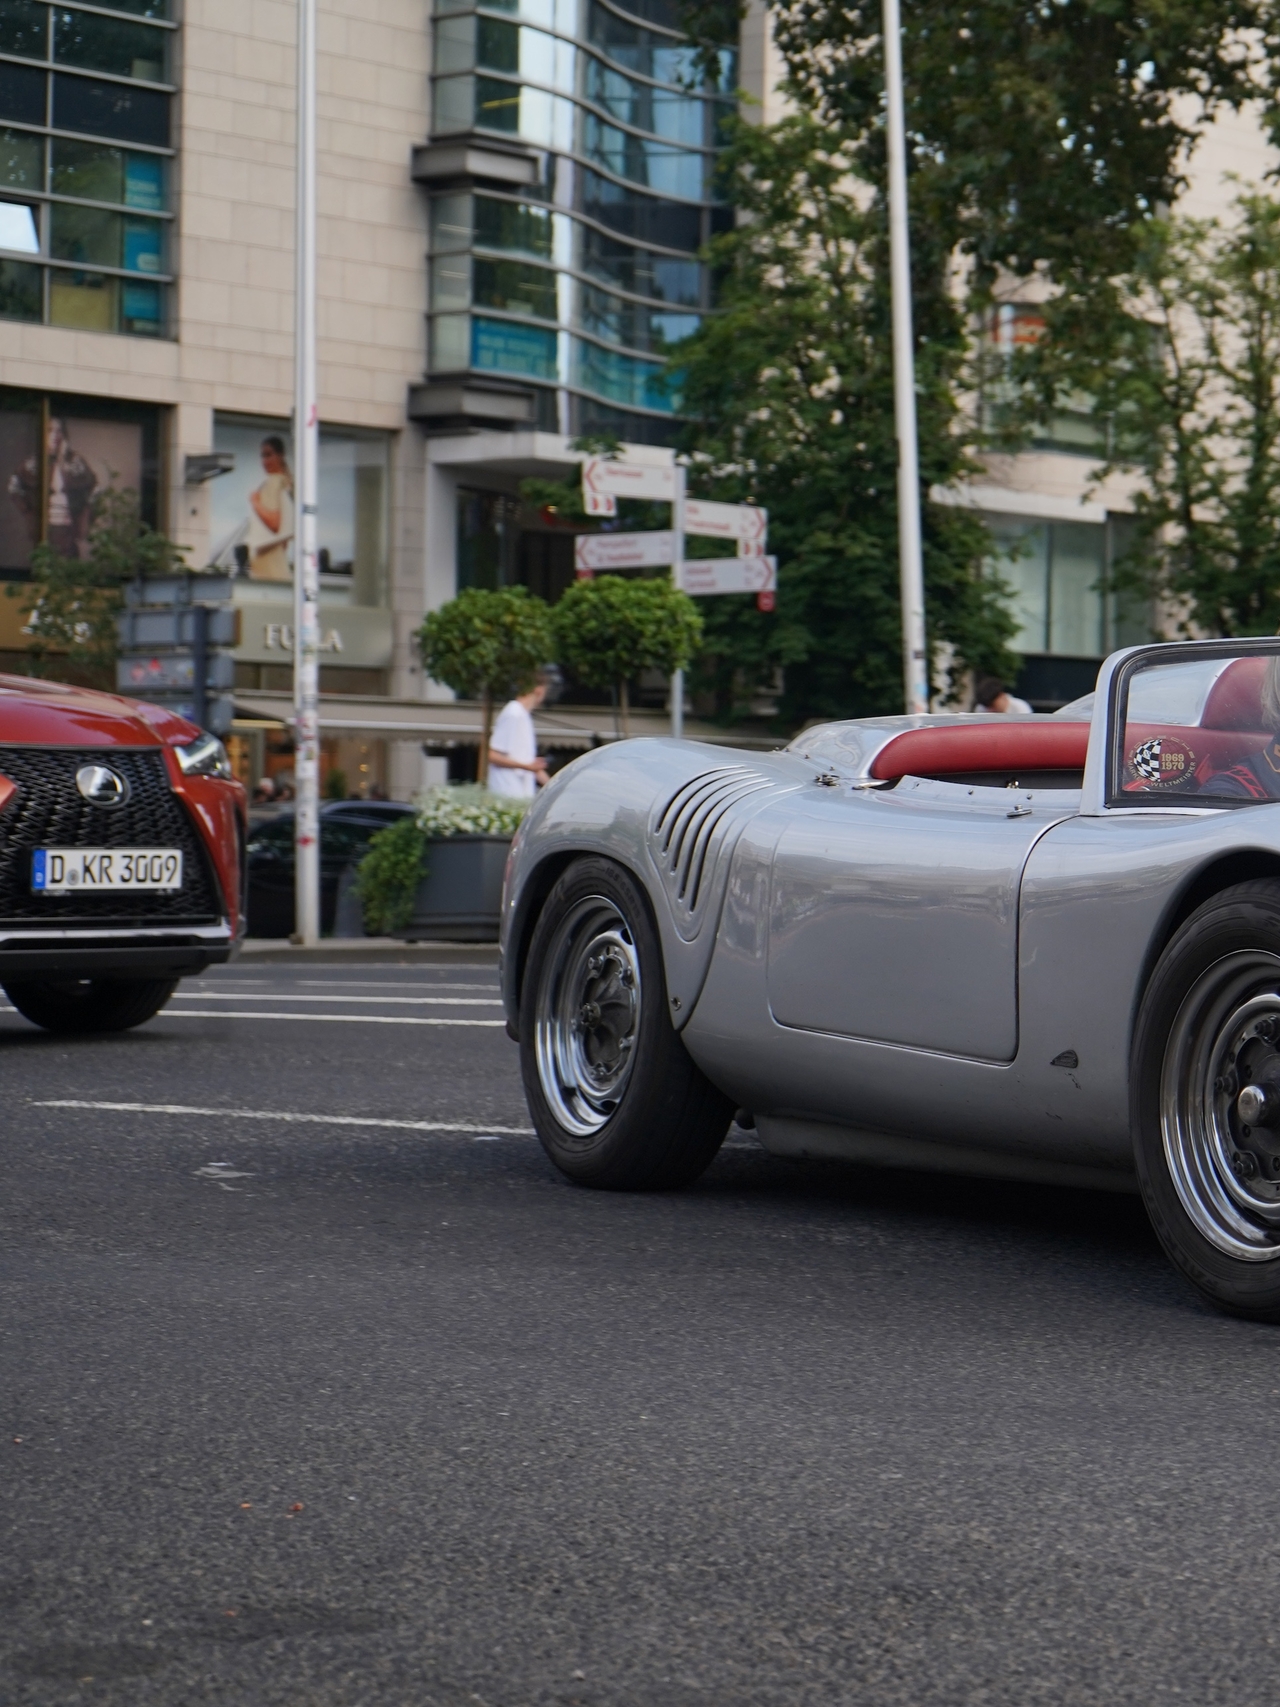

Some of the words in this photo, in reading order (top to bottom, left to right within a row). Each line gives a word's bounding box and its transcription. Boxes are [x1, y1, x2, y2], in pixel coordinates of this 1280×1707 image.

[265, 622, 343, 653] FUA
[1161, 753, 1185, 762] 1969
[1161, 761, 1185, 771] 1970
[50, 855, 64, 884] D
[82, 855, 113, 884] KR
[120, 855, 178, 883] 3009
